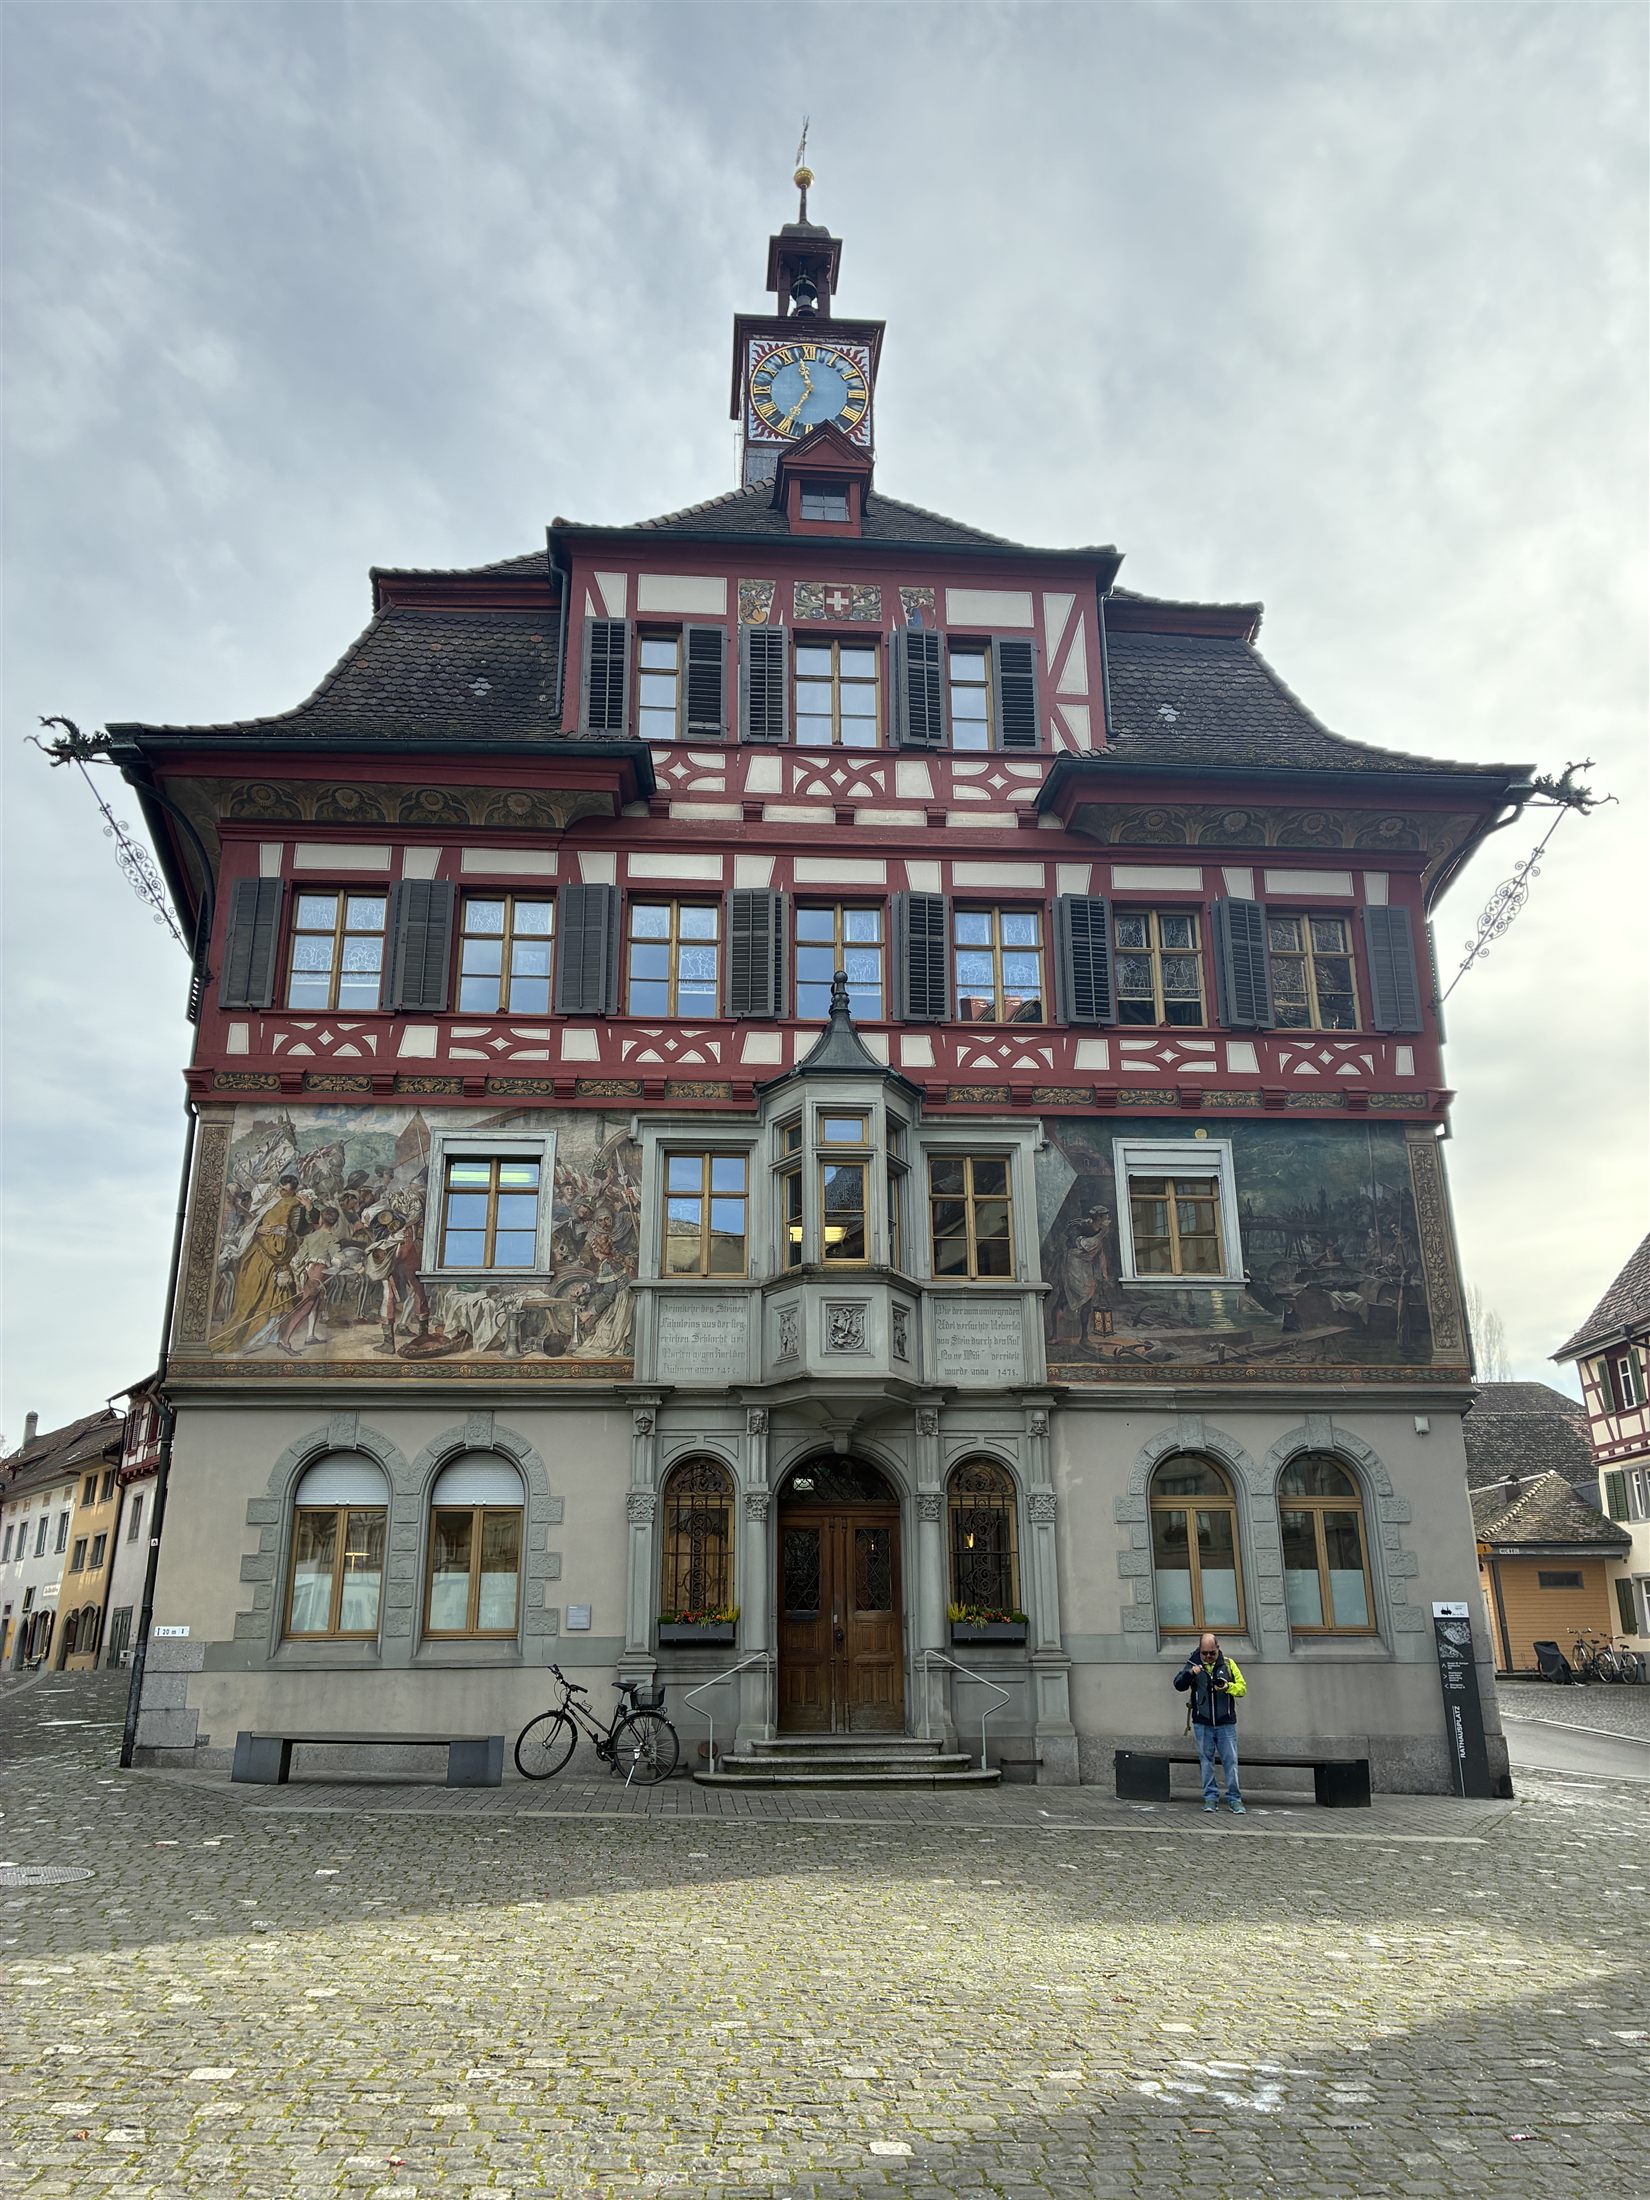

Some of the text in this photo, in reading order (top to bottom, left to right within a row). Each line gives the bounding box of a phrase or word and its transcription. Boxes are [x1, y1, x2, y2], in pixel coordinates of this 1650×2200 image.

[802, 345, 816, 360] XII
[162, 1628, 170, 1636] 20
[1454, 1705, 1466, 1758] RATHAUSPLATZ
